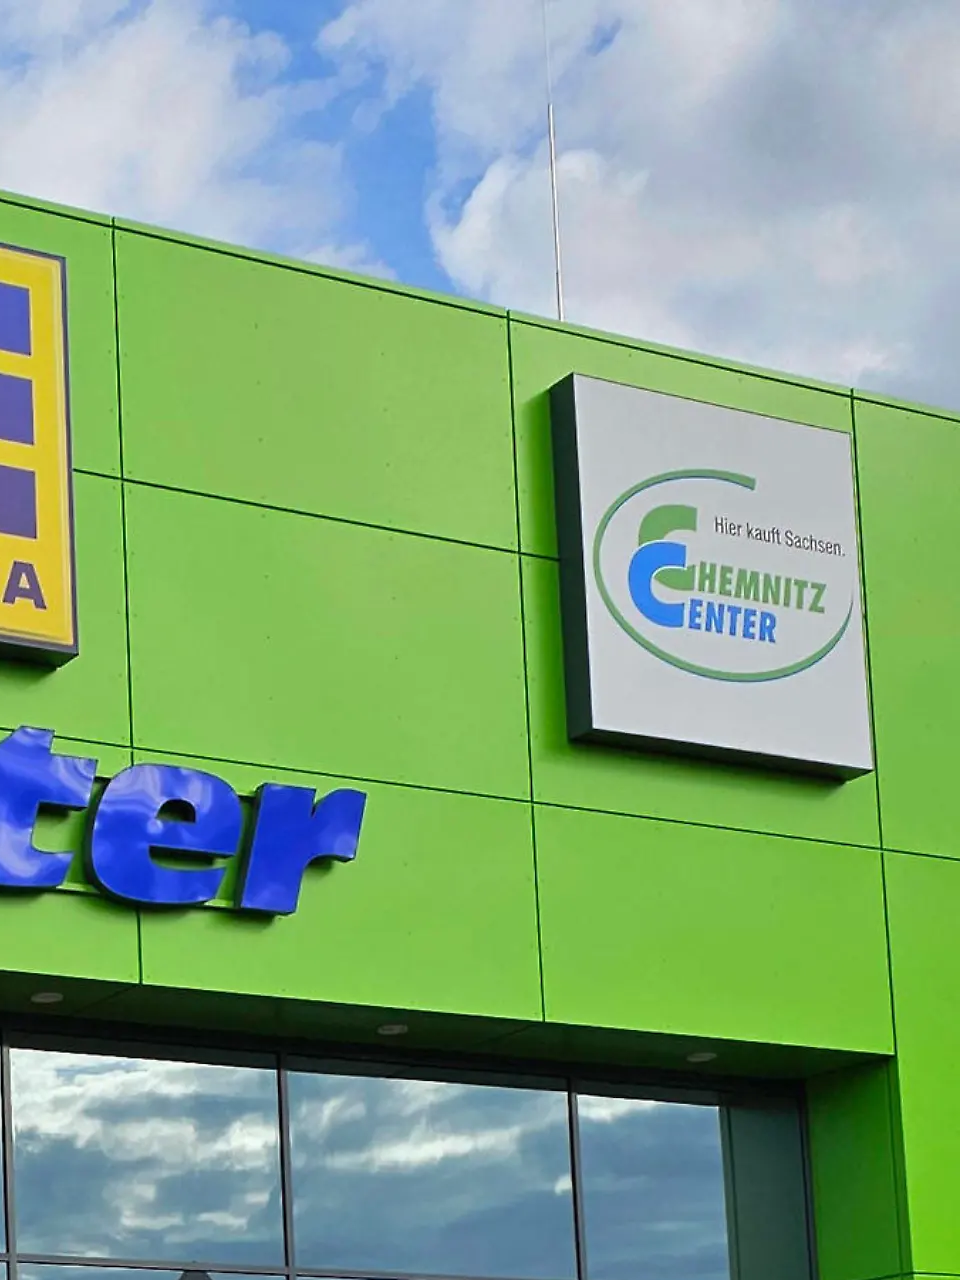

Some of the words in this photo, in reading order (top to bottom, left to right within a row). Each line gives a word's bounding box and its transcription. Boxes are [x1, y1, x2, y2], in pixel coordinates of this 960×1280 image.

[714, 516, 742, 536] Hier
[746, 522, 782, 545] kauft
[784, 530, 846, 557] Sachsen.
[628, 541, 776, 643] CENTER
